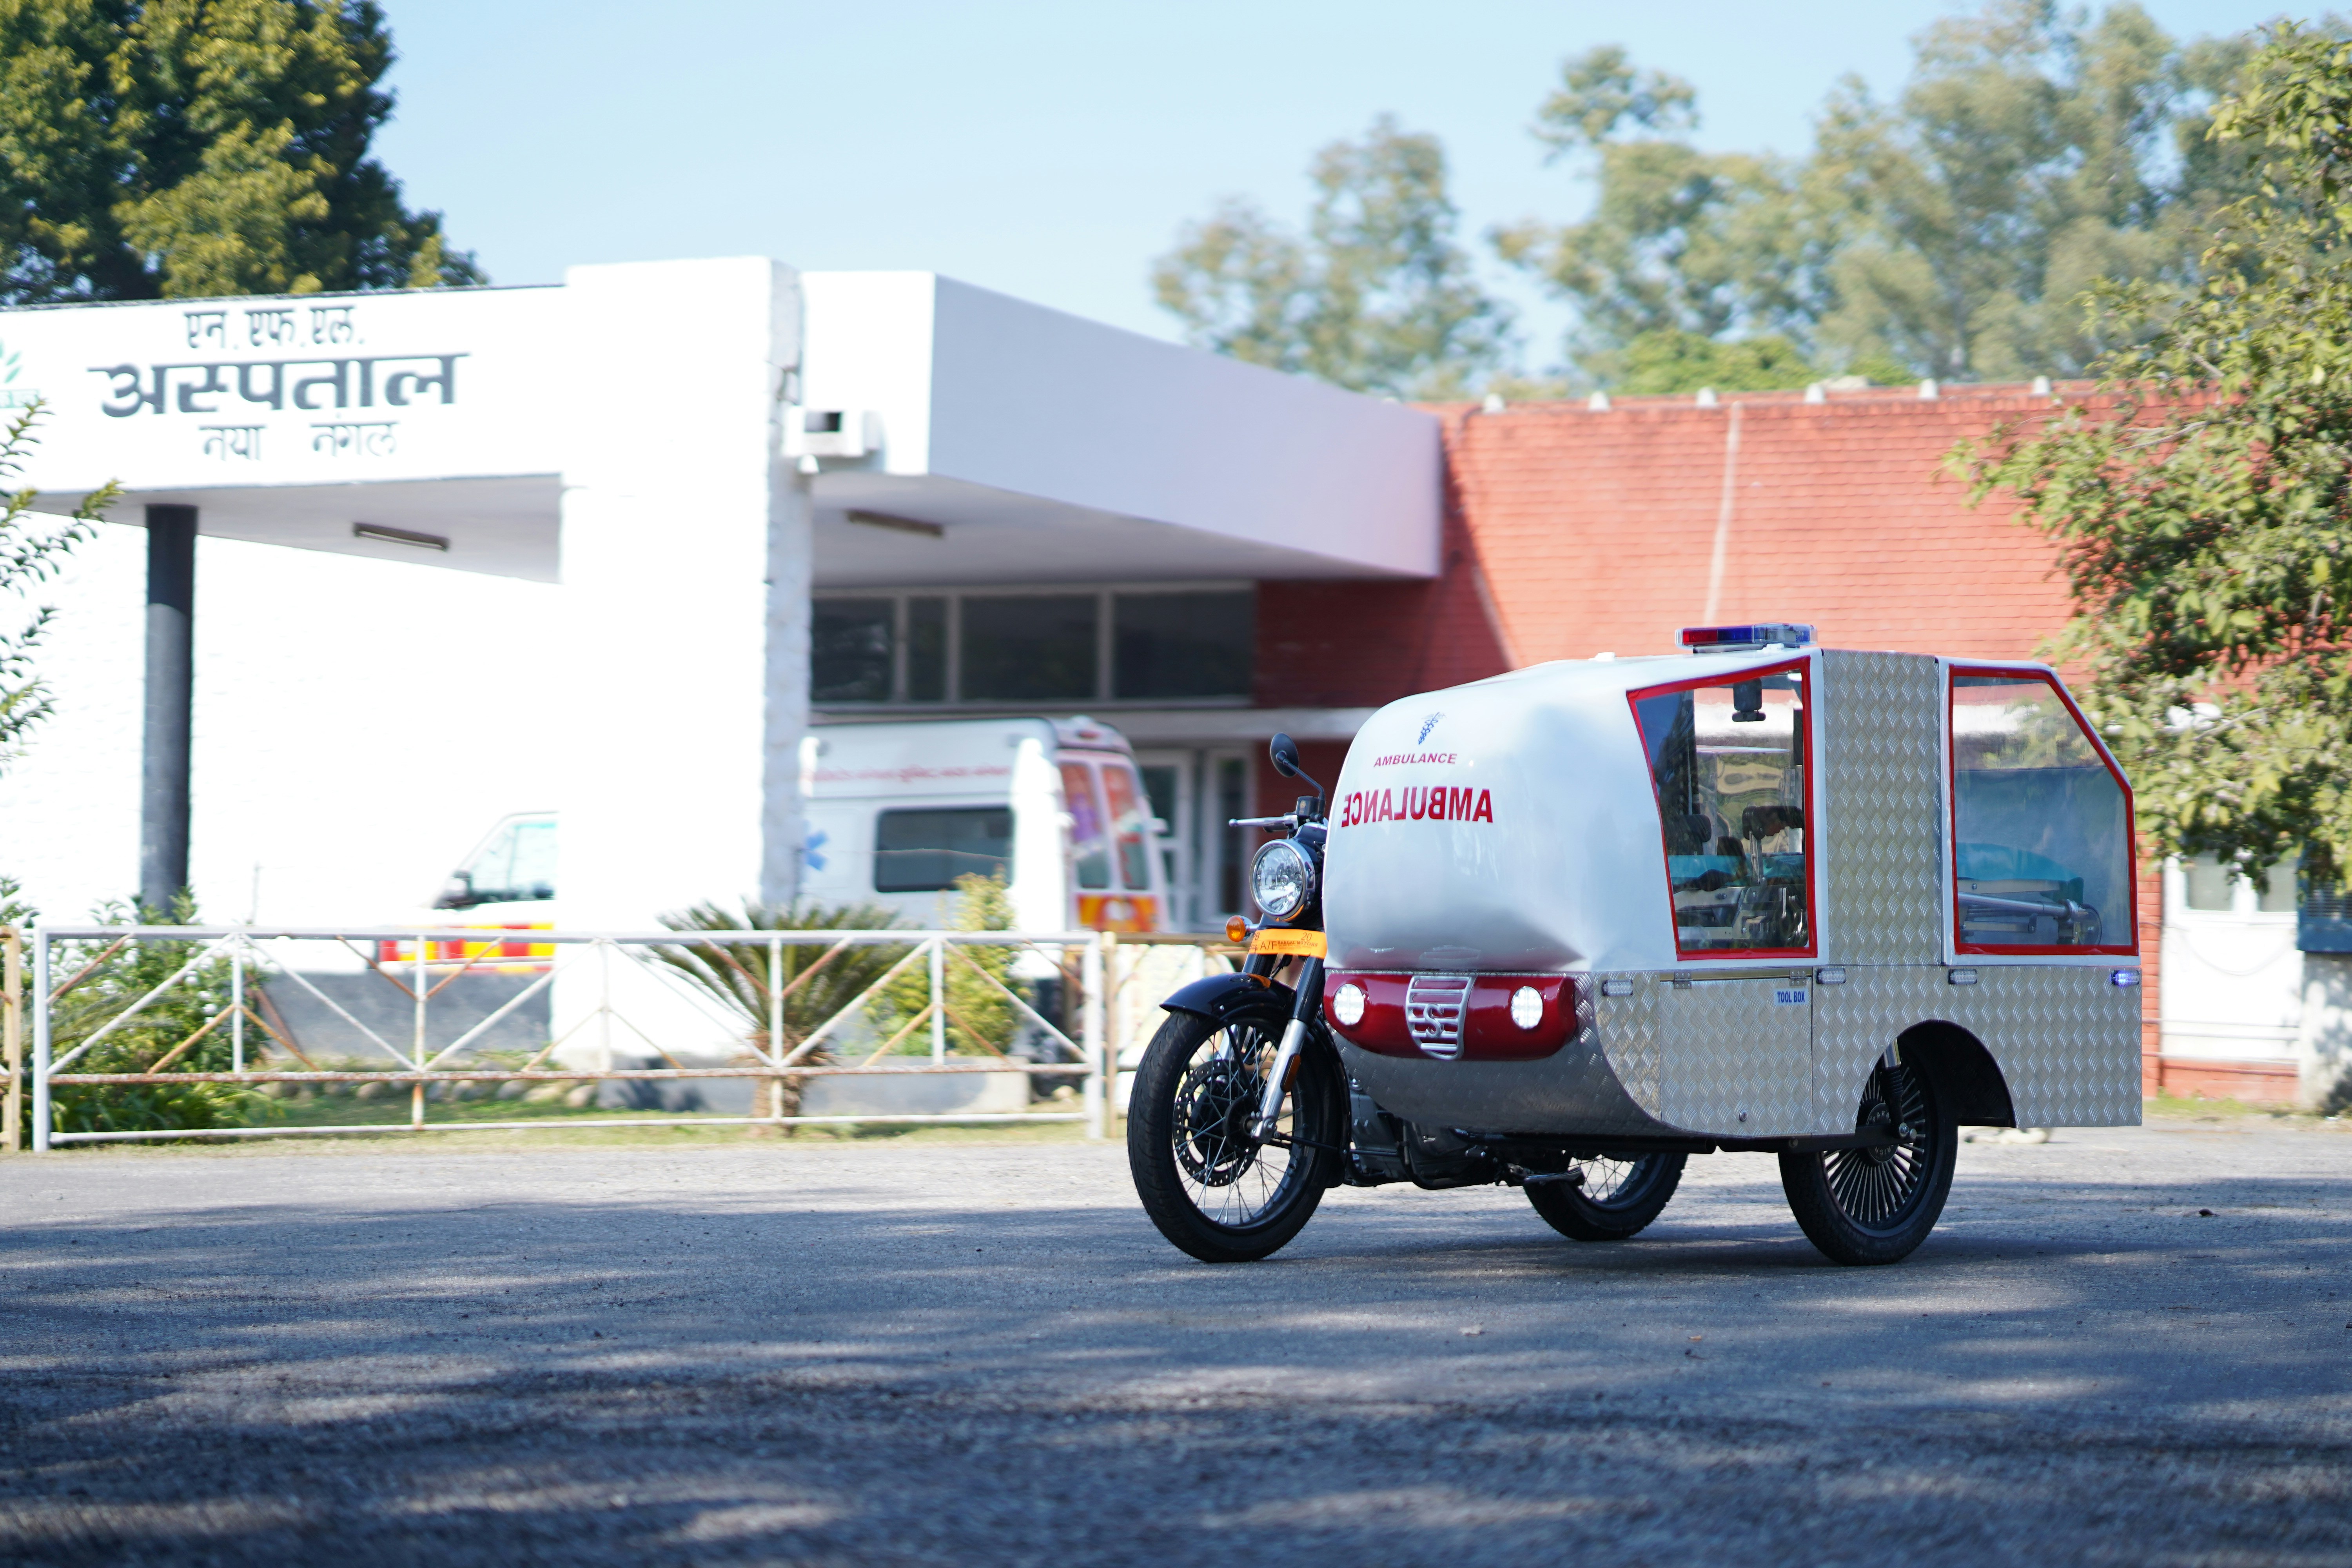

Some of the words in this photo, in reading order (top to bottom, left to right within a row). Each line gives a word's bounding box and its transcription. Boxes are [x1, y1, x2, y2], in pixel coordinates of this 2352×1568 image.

[87, 352, 471, 418] अस्पताल
[198, 424, 268, 462] नया
[309, 414, 401, 457] नंगल
[1374, 753, 1457, 767] AMBULANCE
[1301, 932, 1312, 941] 20
[1260, 941, 1278, 950] A/F
[1777, 991, 1792, 1003] TOOL
[1794, 991, 1805, 1002] BOX
